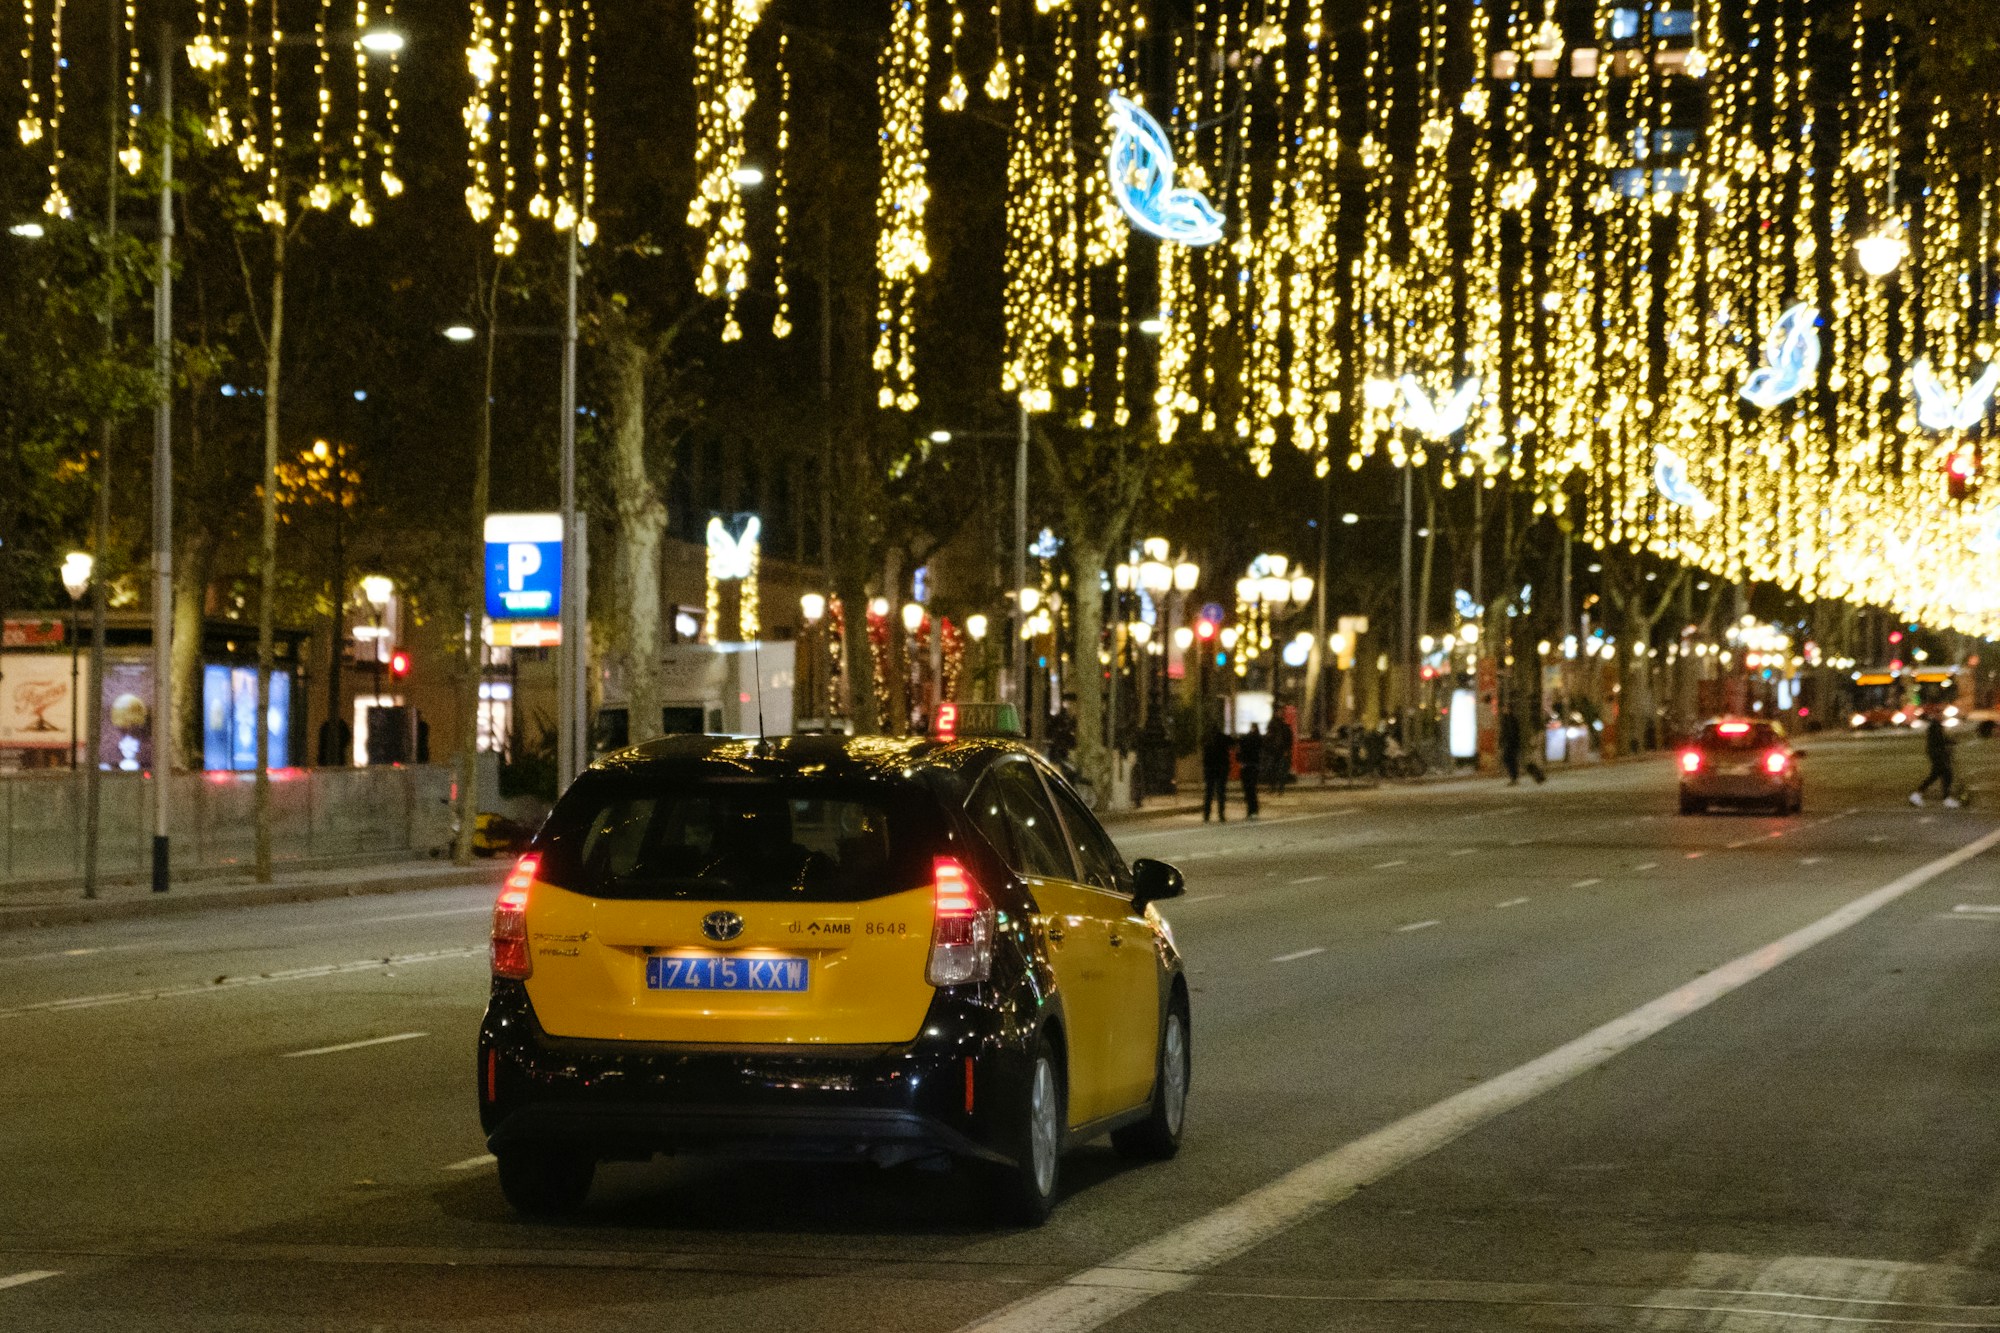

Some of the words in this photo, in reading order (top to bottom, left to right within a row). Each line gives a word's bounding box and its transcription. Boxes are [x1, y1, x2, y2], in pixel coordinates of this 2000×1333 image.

[508, 543, 542, 591] P
[938, 706, 955, 730] 2
[959, 708, 994, 728] TAXI
[823, 923, 851, 934] AMB
[865, 922, 906, 935] 8648
[667, 959, 738, 988] 7415
[749, 961, 802, 989] KXW
